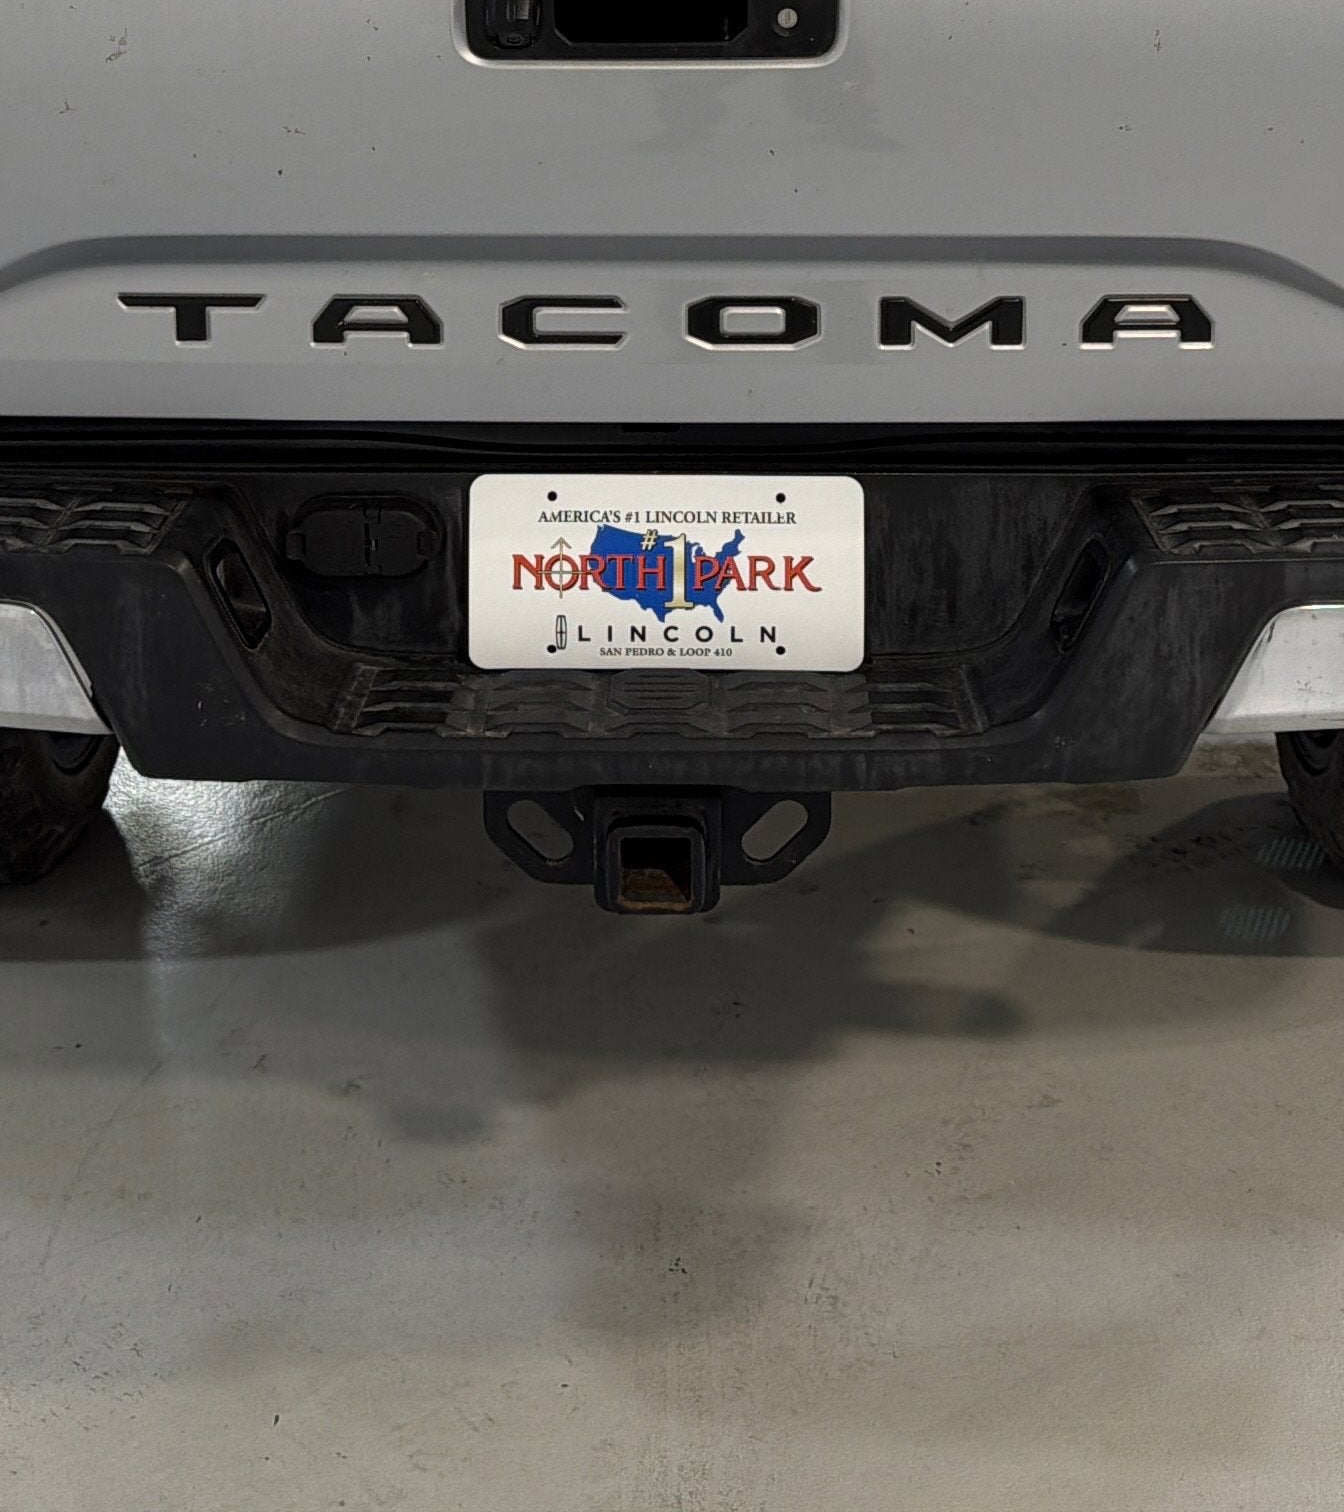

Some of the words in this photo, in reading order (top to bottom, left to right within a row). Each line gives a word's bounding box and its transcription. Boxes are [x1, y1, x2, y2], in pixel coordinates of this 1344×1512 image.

[116, 291, 1215, 350] TACOMA
[537, 510, 621, 524] AMERICA'S
[624, 510, 642, 524] #1
[645, 510, 717, 524] LINCOLN
[721, 510, 797, 525] RETAILER
[512, 553, 666, 591] NORTH
[693, 555, 823, 592] PARK
[577, 624, 777, 643] LINCOLN
[599, 647, 623, 657] SAN
[625, 647, 665, 657] PEDRO
[667, 647, 677, 657] &
[679, 647, 711, 657] LOOP
[713, 647, 733, 657] 410
